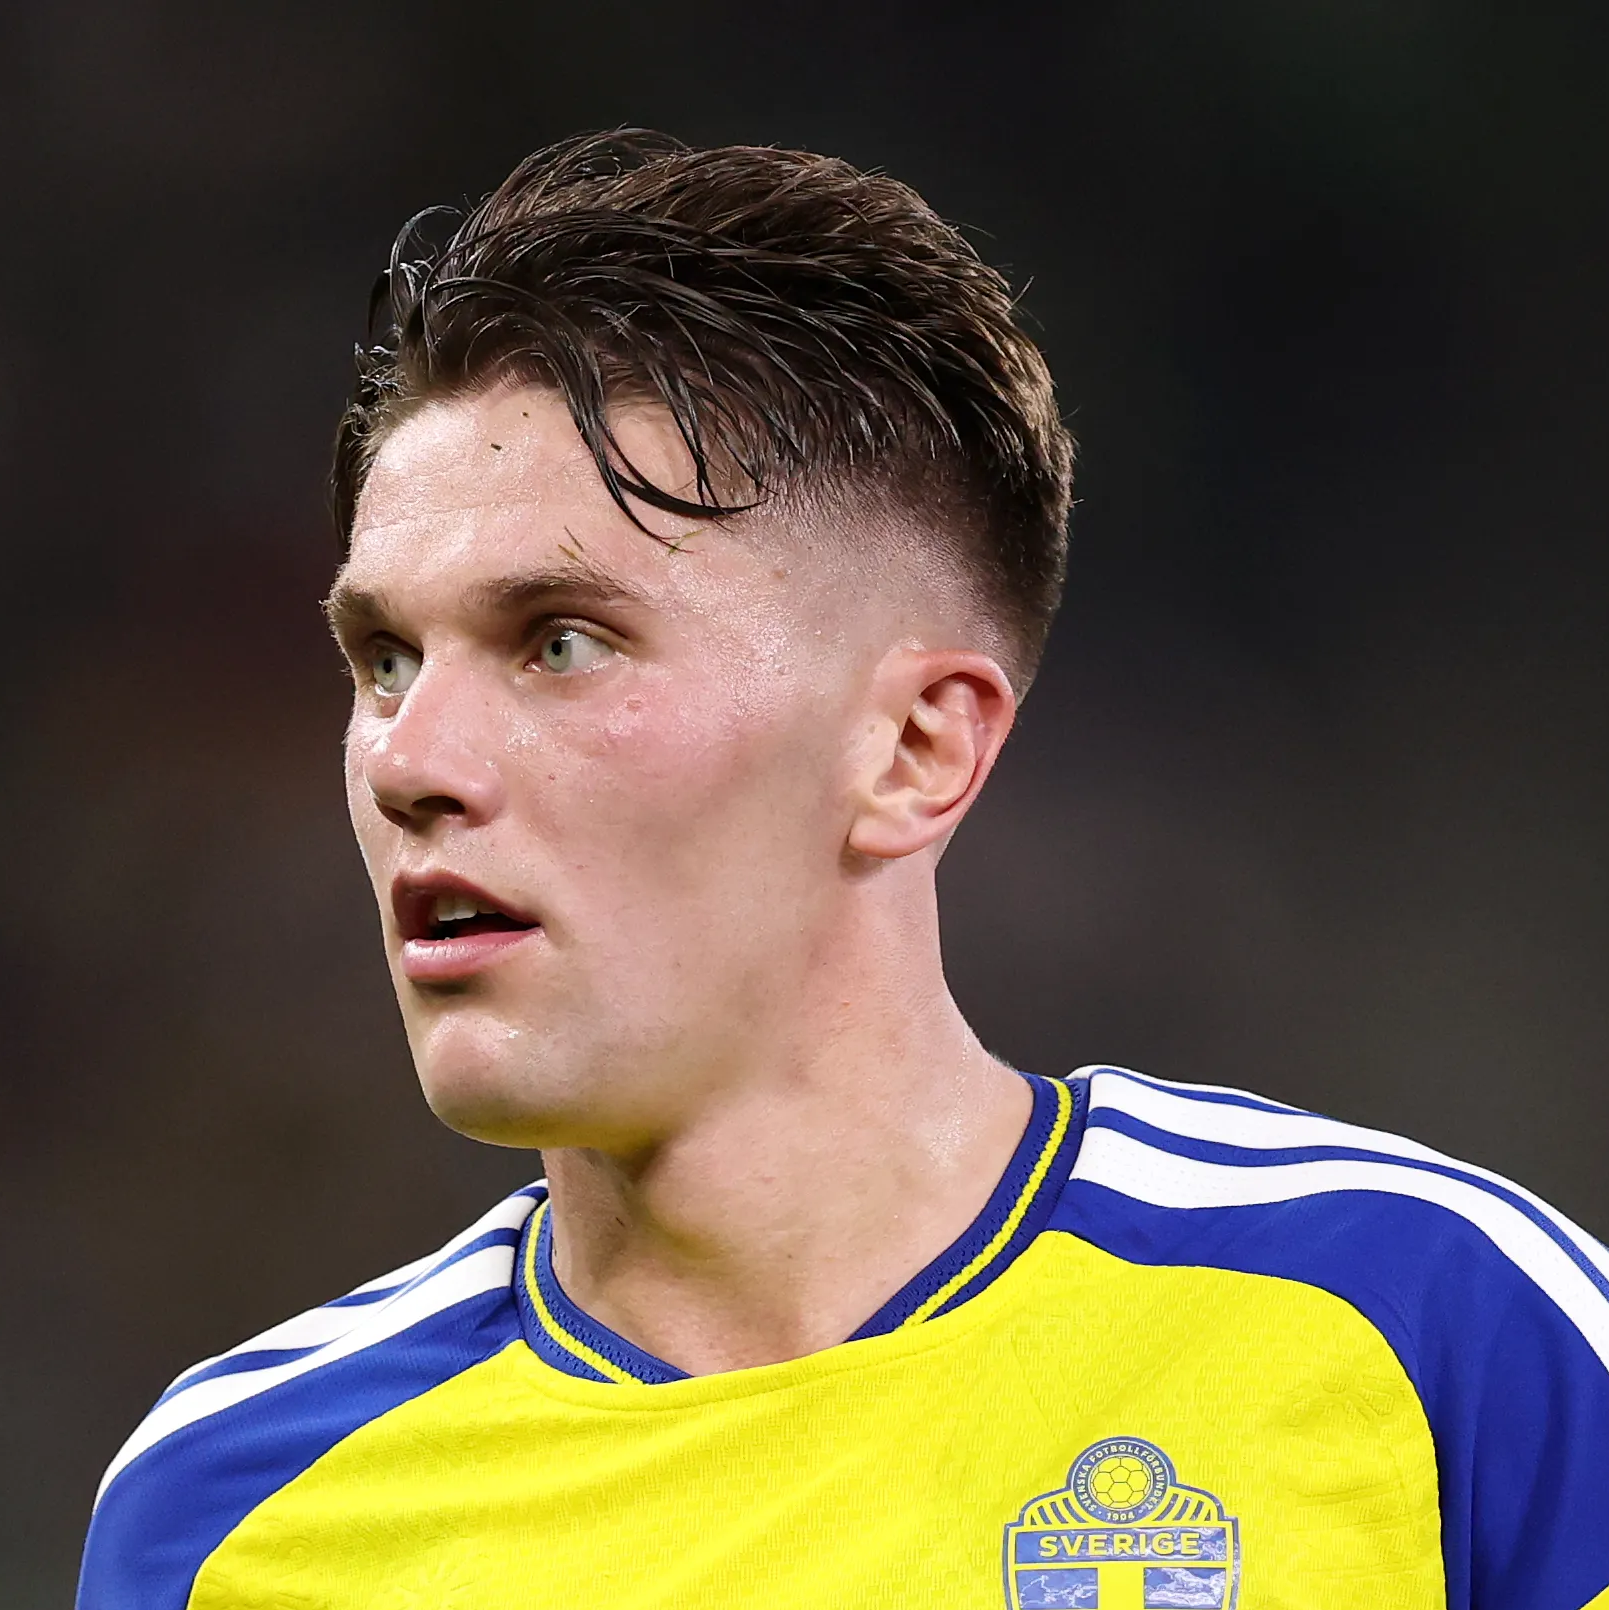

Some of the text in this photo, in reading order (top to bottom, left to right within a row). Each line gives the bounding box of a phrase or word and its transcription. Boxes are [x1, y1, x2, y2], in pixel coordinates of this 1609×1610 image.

[1077, 1463, 1097, 1512] SVENSKA
[1106, 1511, 1135, 1521] 1904
[1039, 1531, 1200, 1557] SVERIGE
